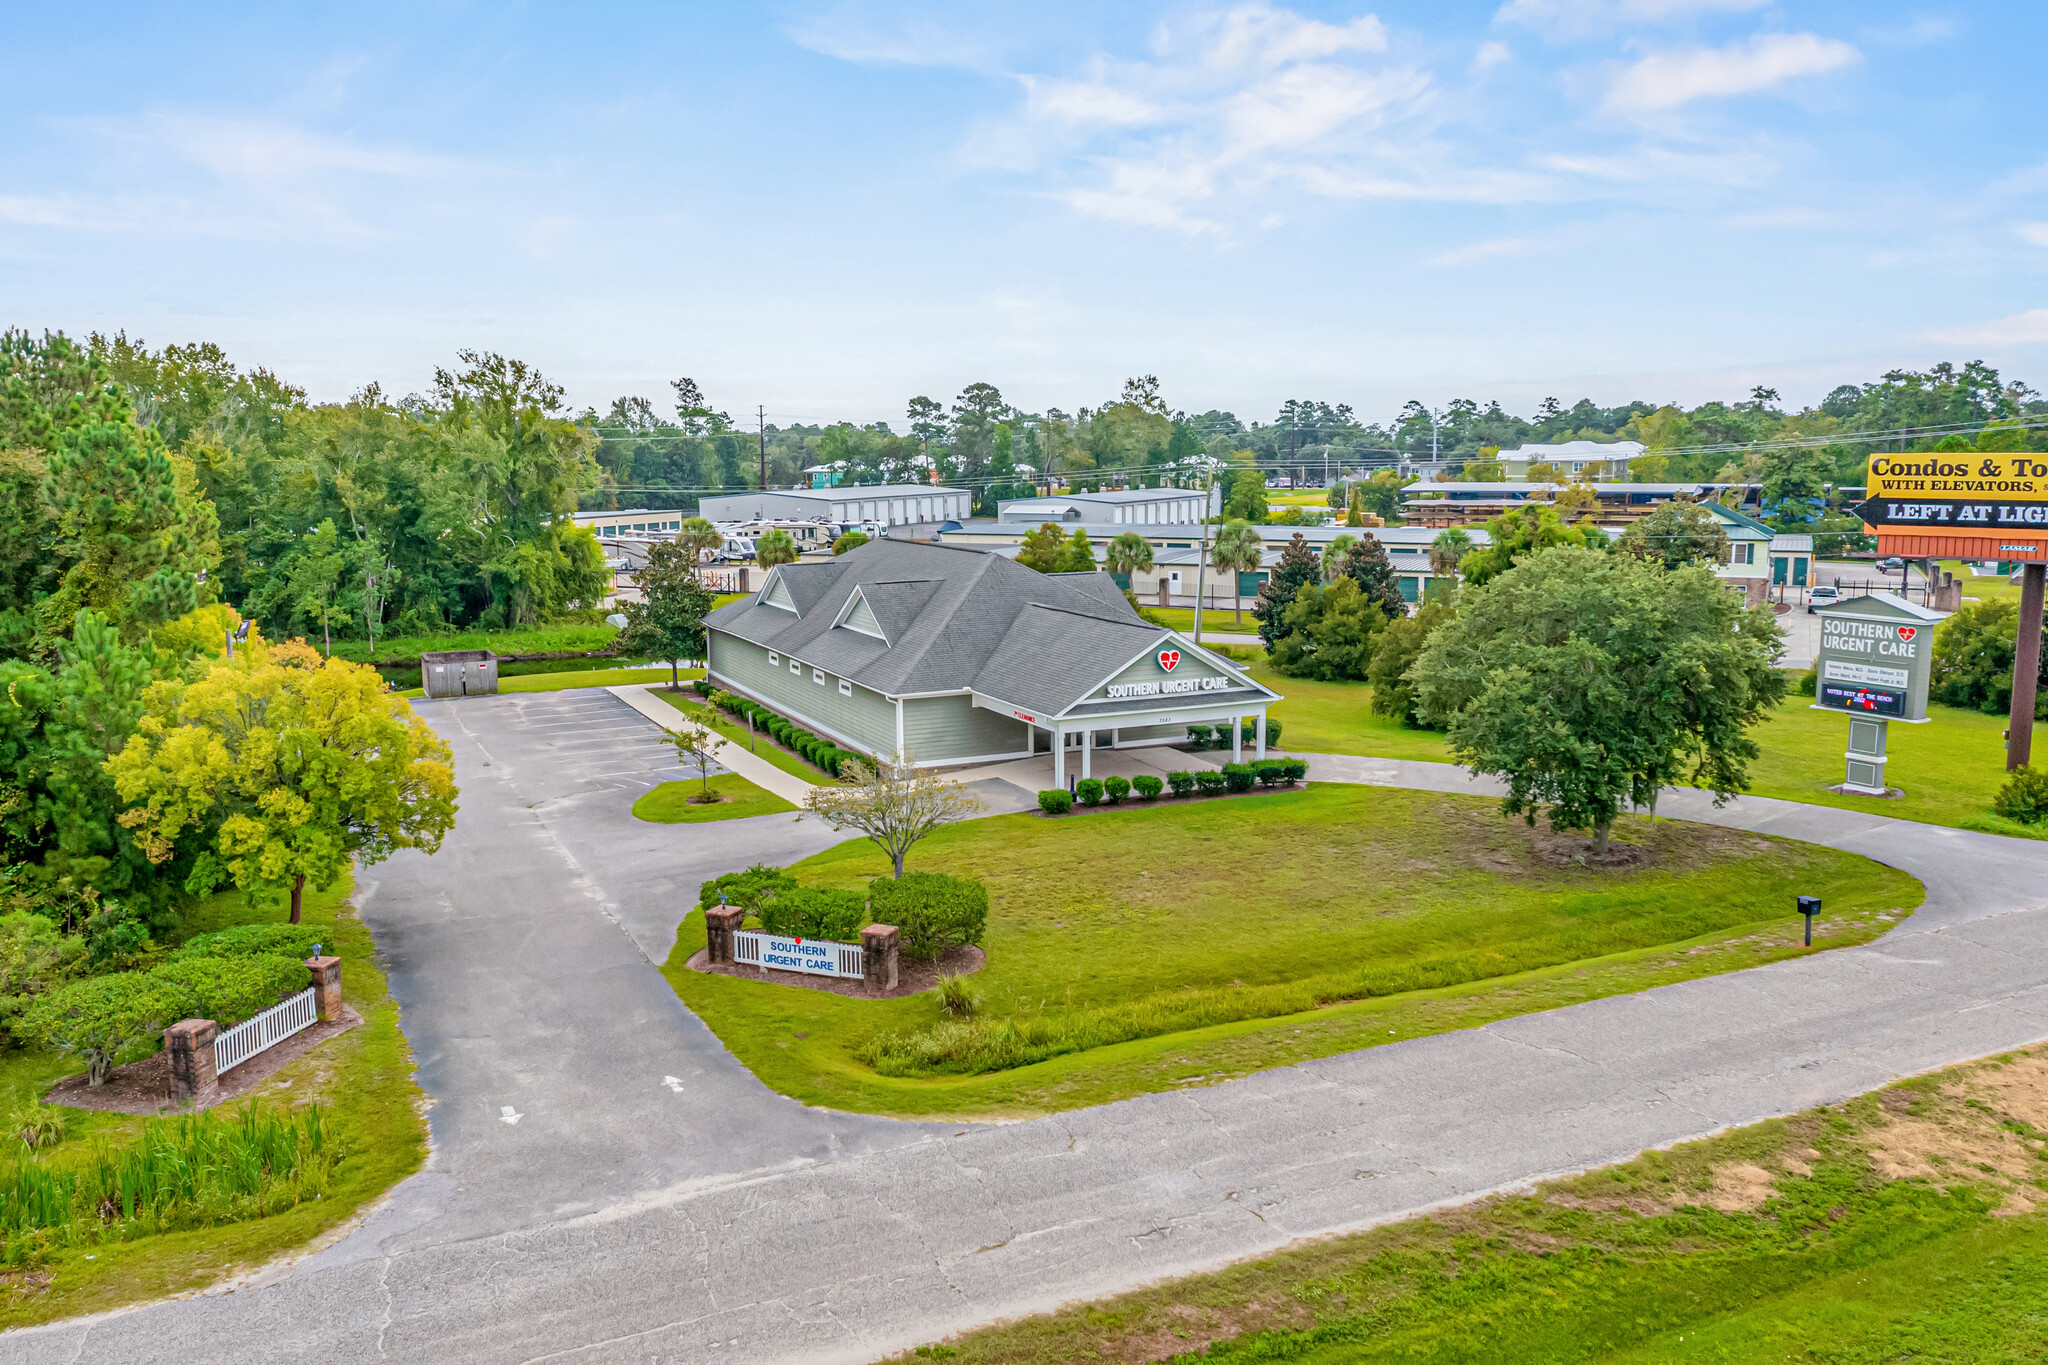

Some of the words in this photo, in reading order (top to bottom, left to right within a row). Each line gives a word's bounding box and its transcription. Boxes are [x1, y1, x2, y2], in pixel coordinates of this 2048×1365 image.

[1871, 458, 1969, 477] Condos
[1978, 458, 2002, 477] &
[2011, 459, 2048, 478] To
[1881, 479, 1925, 490] WITH
[1930, 480, 2038, 493] ELEVATORS,
[1887, 503, 1953, 520] LEFT
[1957, 505, 1992, 522] AT
[1823, 619, 1894, 640] SOUTHERN
[1823, 635, 1875, 653] URGENT
[1879, 641, 1916, 658] CARE
[1106, 681, 1160, 698] SOUTHERN
[1161, 679, 1201, 694] URGENT
[1201, 676, 1229, 690] CARE
[1826, 688, 1842, 696] VOTED
[1876, 695, 1893, 703] BEACH
[770, 941, 827, 957] SOUTHERN
[763, 953, 803, 967] URGENT
[806, 958, 834, 971] CARE
